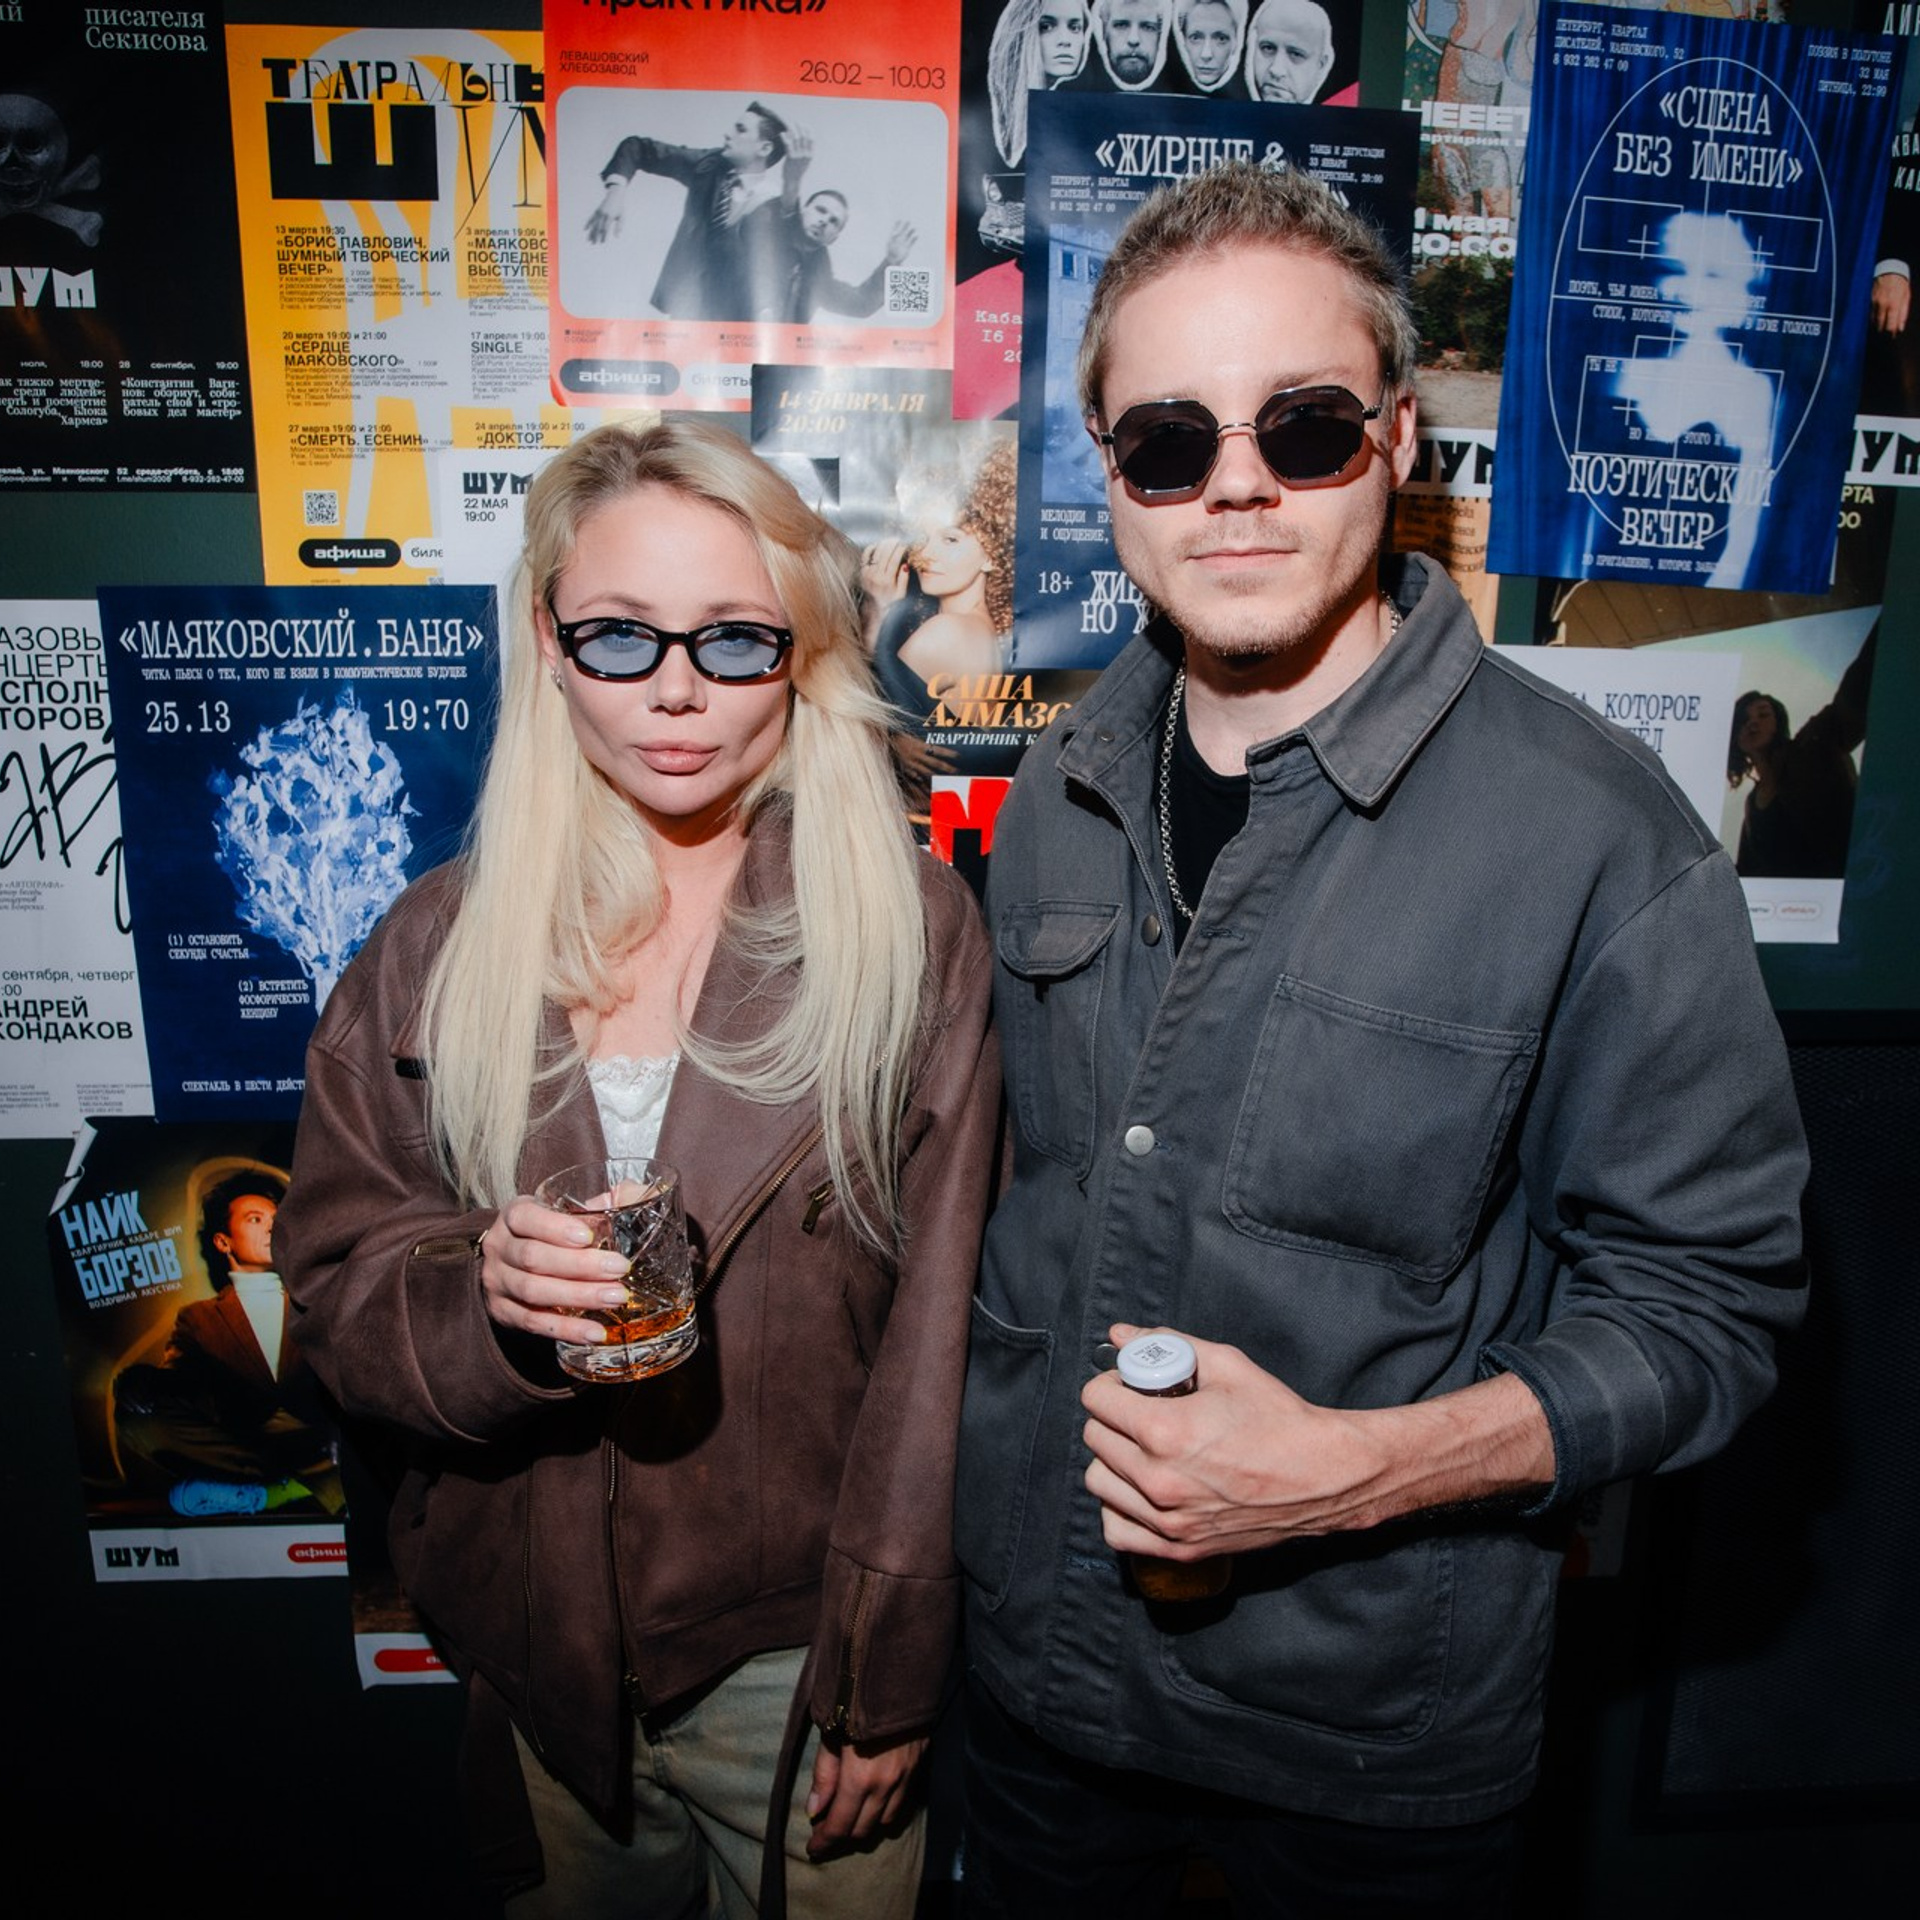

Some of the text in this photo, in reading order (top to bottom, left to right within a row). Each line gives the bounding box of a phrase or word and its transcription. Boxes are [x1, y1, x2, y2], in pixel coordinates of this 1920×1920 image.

[84, 8, 206, 29] писателя
[85, 26, 208, 52] Секисова
[559, 49, 649, 63] ЛЕВАШОВСКИЙ
[559, 63, 637, 76] ХЛЕБОЗАВОД
[799, 60, 862, 85] 26.02
[890, 65, 946, 90] 10.03
[1658, 84, 1773, 136] «СЦЕНА
[1613, 131, 1804, 189] БЕЗ ИМЕНИ»
[1433, 213, 1511, 233] мая
[275, 226, 346, 237] 13 марта 19:30
[466, 227, 472, 236] 3
[474, 228, 509, 237] апреля
[513, 229, 536, 237] 19:00
[276, 236, 426, 249] «БОРИС ПАВЛОВИЧ.
[467, 237, 548, 250] «МАЯКОВС
[277, 247, 450, 262] ШУМНЫЙ ТВОРЧЕСКИЙ
[467, 251, 548, 264] ПОСЛЕДНЕ
[278, 263, 333, 276] ВЕЧЕР»
[468, 264, 548, 277] ВЫСТУПЛЕ
[975, 310, 1023, 325] Каба
[1782, 320, 1821, 336] ГОЛОСОВ
[283, 332, 294, 340] 20
[296, 333, 324, 342] марта
[327, 332, 352, 340] 19:00
[362, 332, 387, 340] 21:00
[471, 332, 546, 342] 17 апреля 19:00
[284, 341, 350, 355] «СЕРДЦЕ
[471, 341, 523, 354] SINGLE
[80, 360, 103, 369] 18:00
[119, 361, 240, 370] 28 сентября, 19:00
[285, 354, 405, 367] МАЯКОВСКОГО»
[17, 379, 105, 390] тяжко мертве-
[121, 378, 240, 389] «Константин Ваги-
[579, 368, 661, 387] афиша
[14, 388, 47, 398] среди
[122, 390, 146, 398] нов:
[210, 389, 241, 399] соби-
[47, 398, 108, 409] посмертие
[123, 400, 161, 409] ратель
[166, 400, 193, 408] снов
[6, 406, 108, 418] Сологуба, Блока
[123, 407, 243, 420] бовых дел мастер»
[61, 416, 108, 429] Хармса»
[288, 424, 299, 433] 27
[302, 425, 330, 434] марта
[333, 424, 357, 433] 19:00
[368, 424, 392, 433] 21:00
[475, 422, 486, 431] 24
[488, 423, 523, 432] апреля
[526, 422, 550, 431] 19:00
[560, 422, 585, 431] 21:00
[776, 414, 846, 434] 20:00
[291, 434, 360, 446] «СМЕРТЬ.
[364, 434, 429, 446] ЕСЕНИН»
[477, 432, 545, 446] «ДОКТОР
[463, 472, 533, 495] ШУМ
[464, 498, 509, 509] 22 МАЯ
[465, 511, 496, 523] 19:00
[1040, 508, 1086, 526] МЕЛОДИИ
[1040, 527, 1109, 544] И ОЩУЩЕНИЕ,
[1618, 506, 1715, 551] ВЕЧЕР
[314, 545, 387, 562] афиша
[1038, 571, 1074, 594] 18+
[1080, 601, 1118, 634] НО
[141, 666, 468, 682] ЧИТКА ПЬЕСЫ О ТЕХ, КОГО НЕ ВЗЯЛИ В КОММУНИСТИЧЕСКОЕ БУДУЩЕЕ
[927, 672, 1034, 701] САША
[1604, 692, 1701, 721] КОТОРОЕ
[145, 701, 232, 734] 25.13
[384, 698, 470, 732] 19:70
[925, 731, 1022, 746] КВАРТИРНИК
[1626, 721, 1664, 753] ЁЛ
[168, 933, 243, 947] (1) ОСТАНОВИТЬ
[168, 948, 250, 961] СЕКУНДЫ СЧАСТЬЯ
[2, 968, 135, 983] сентября, четверг
[238, 979, 309, 993] (2) ВСТРЕТИТЬ
[238, 993, 310, 1006] ФОСФОРИЧЕСКУЮ
[240, 1007, 279, 1021] ЖЕНЩИНУ
[181, 1080, 231, 1093] СПЕКТАКЛЬ
[234, 1080, 241, 1092] В
[276, 1077, 306, 1093] ДЕЙСТ
[59, 1190, 149, 1250] НАЙК
[128, 1230, 160, 1245] КАБАРЕ
[74, 1238, 183, 1300] БОРЗОВ
[104, 1545, 180, 1568] ШУМ
